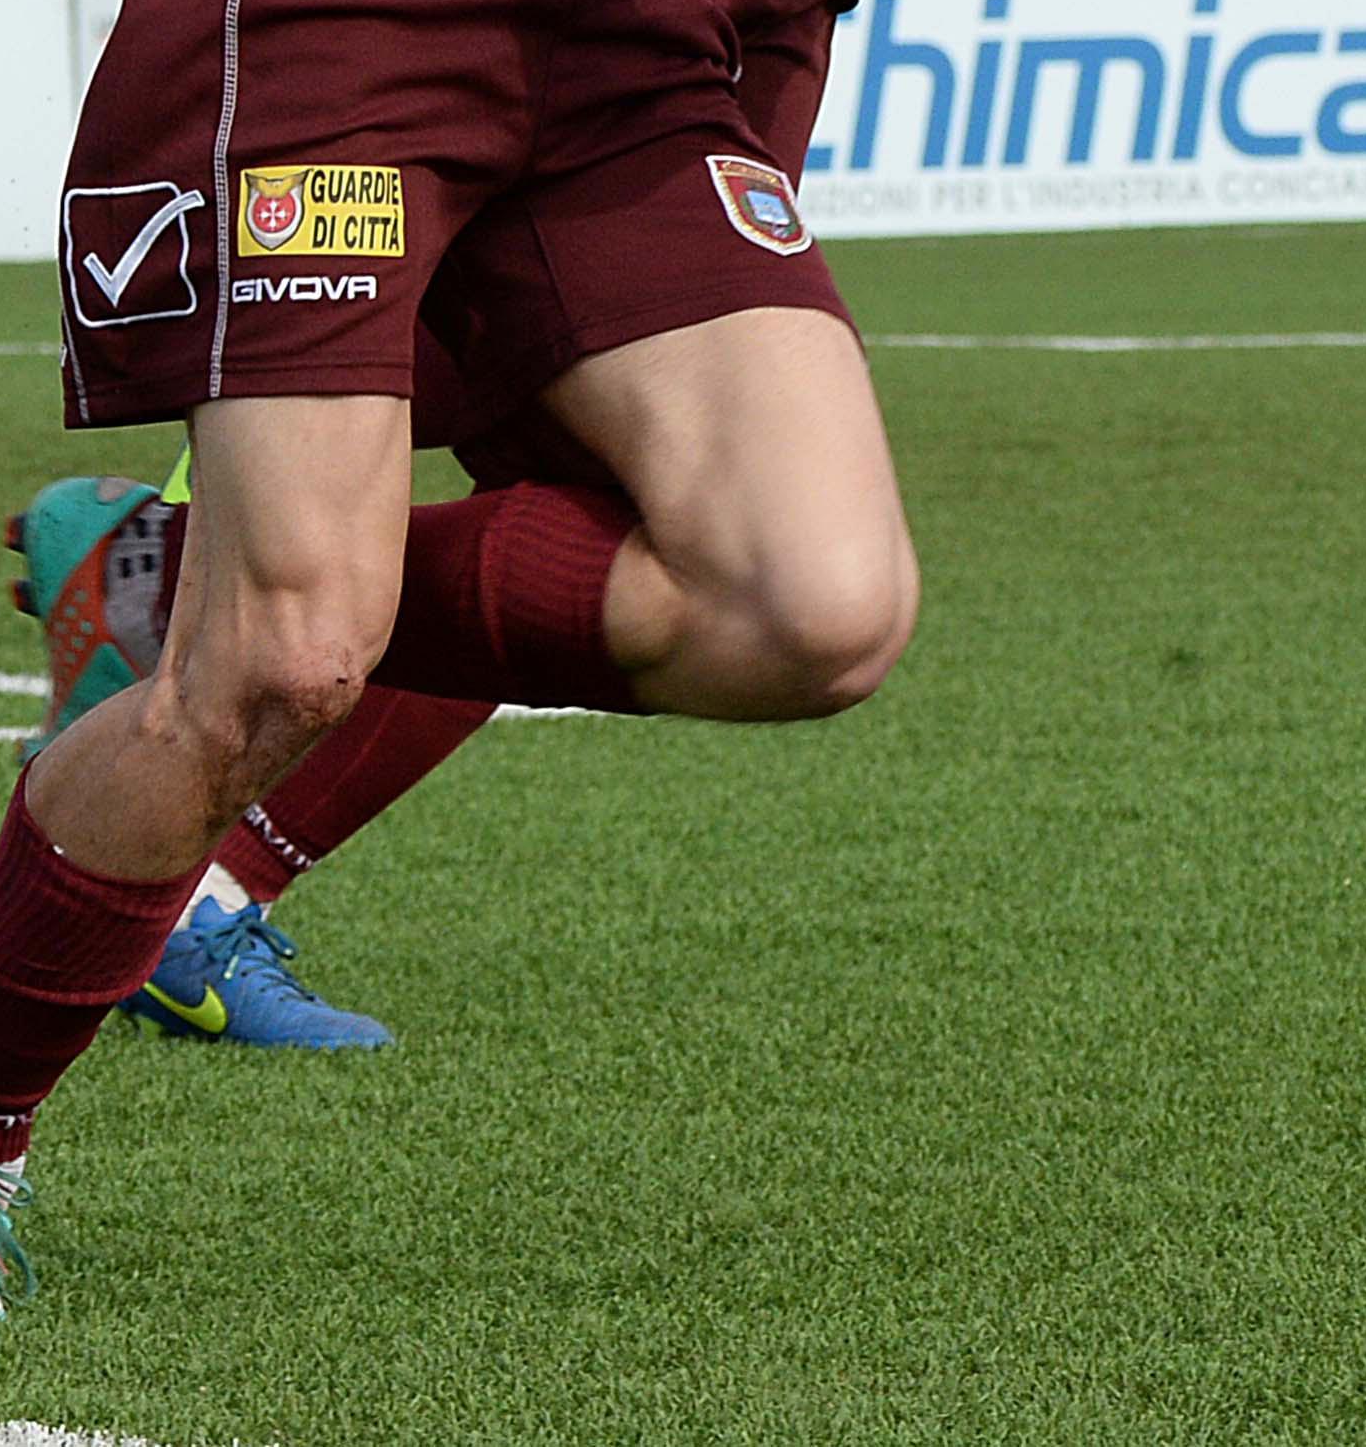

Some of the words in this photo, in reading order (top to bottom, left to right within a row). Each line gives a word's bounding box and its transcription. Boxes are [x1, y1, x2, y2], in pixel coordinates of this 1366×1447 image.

[311, 170, 399, 205] GUARDIE
[312, 215, 337, 249] DI
[344, 209, 400, 251] CITTÀ
[232, 275, 377, 303] GIVOVA
